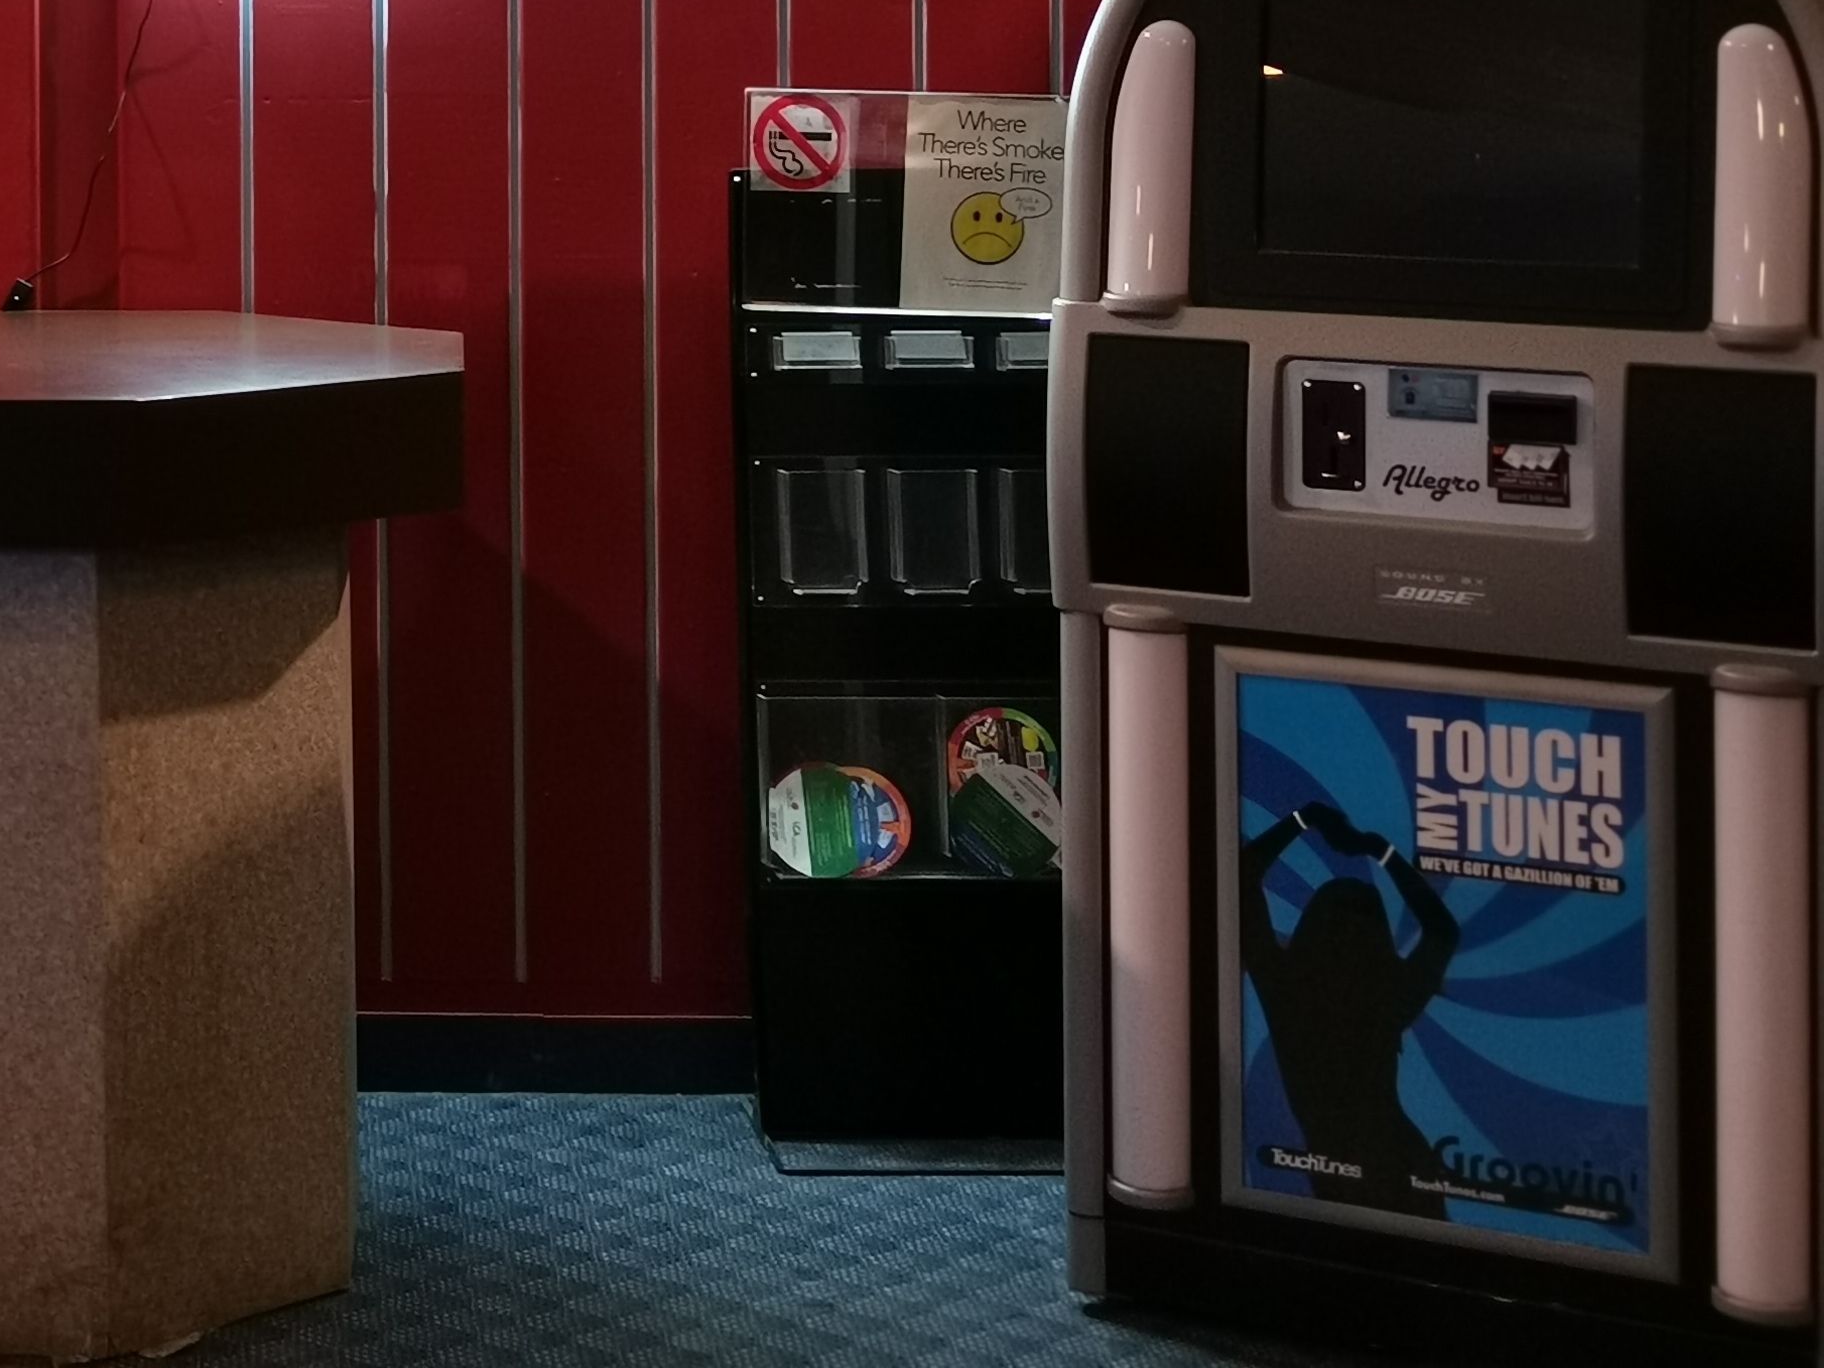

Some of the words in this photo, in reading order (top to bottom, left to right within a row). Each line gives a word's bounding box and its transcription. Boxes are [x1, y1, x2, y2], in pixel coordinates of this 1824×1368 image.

[957, 109, 1026, 133] Where
[918, 132, 988, 156] There's
[992, 136, 1064, 161] Smoke
[933, 157, 1005, 182] There's
[1009, 162, 1047, 184] Fire
[1383, 464, 1480, 502] Allegro
[1381, 585, 1485, 606] BOSE
[1406, 715, 1623, 799] TOUCH
[1416, 783, 1459, 851] MY
[1457, 788, 1624, 869] TUNES
[1419, 855, 1462, 873] WE'VE
[1463, 860, 1489, 878] GOT
[1491, 863, 1503, 879] A
[1504, 865, 1573, 887] GAZILLION
[1574, 873, 1593, 889] OF
[1270, 1147, 1363, 1179] TouchTunes
[1434, 1135, 1637, 1207] Groovin'
